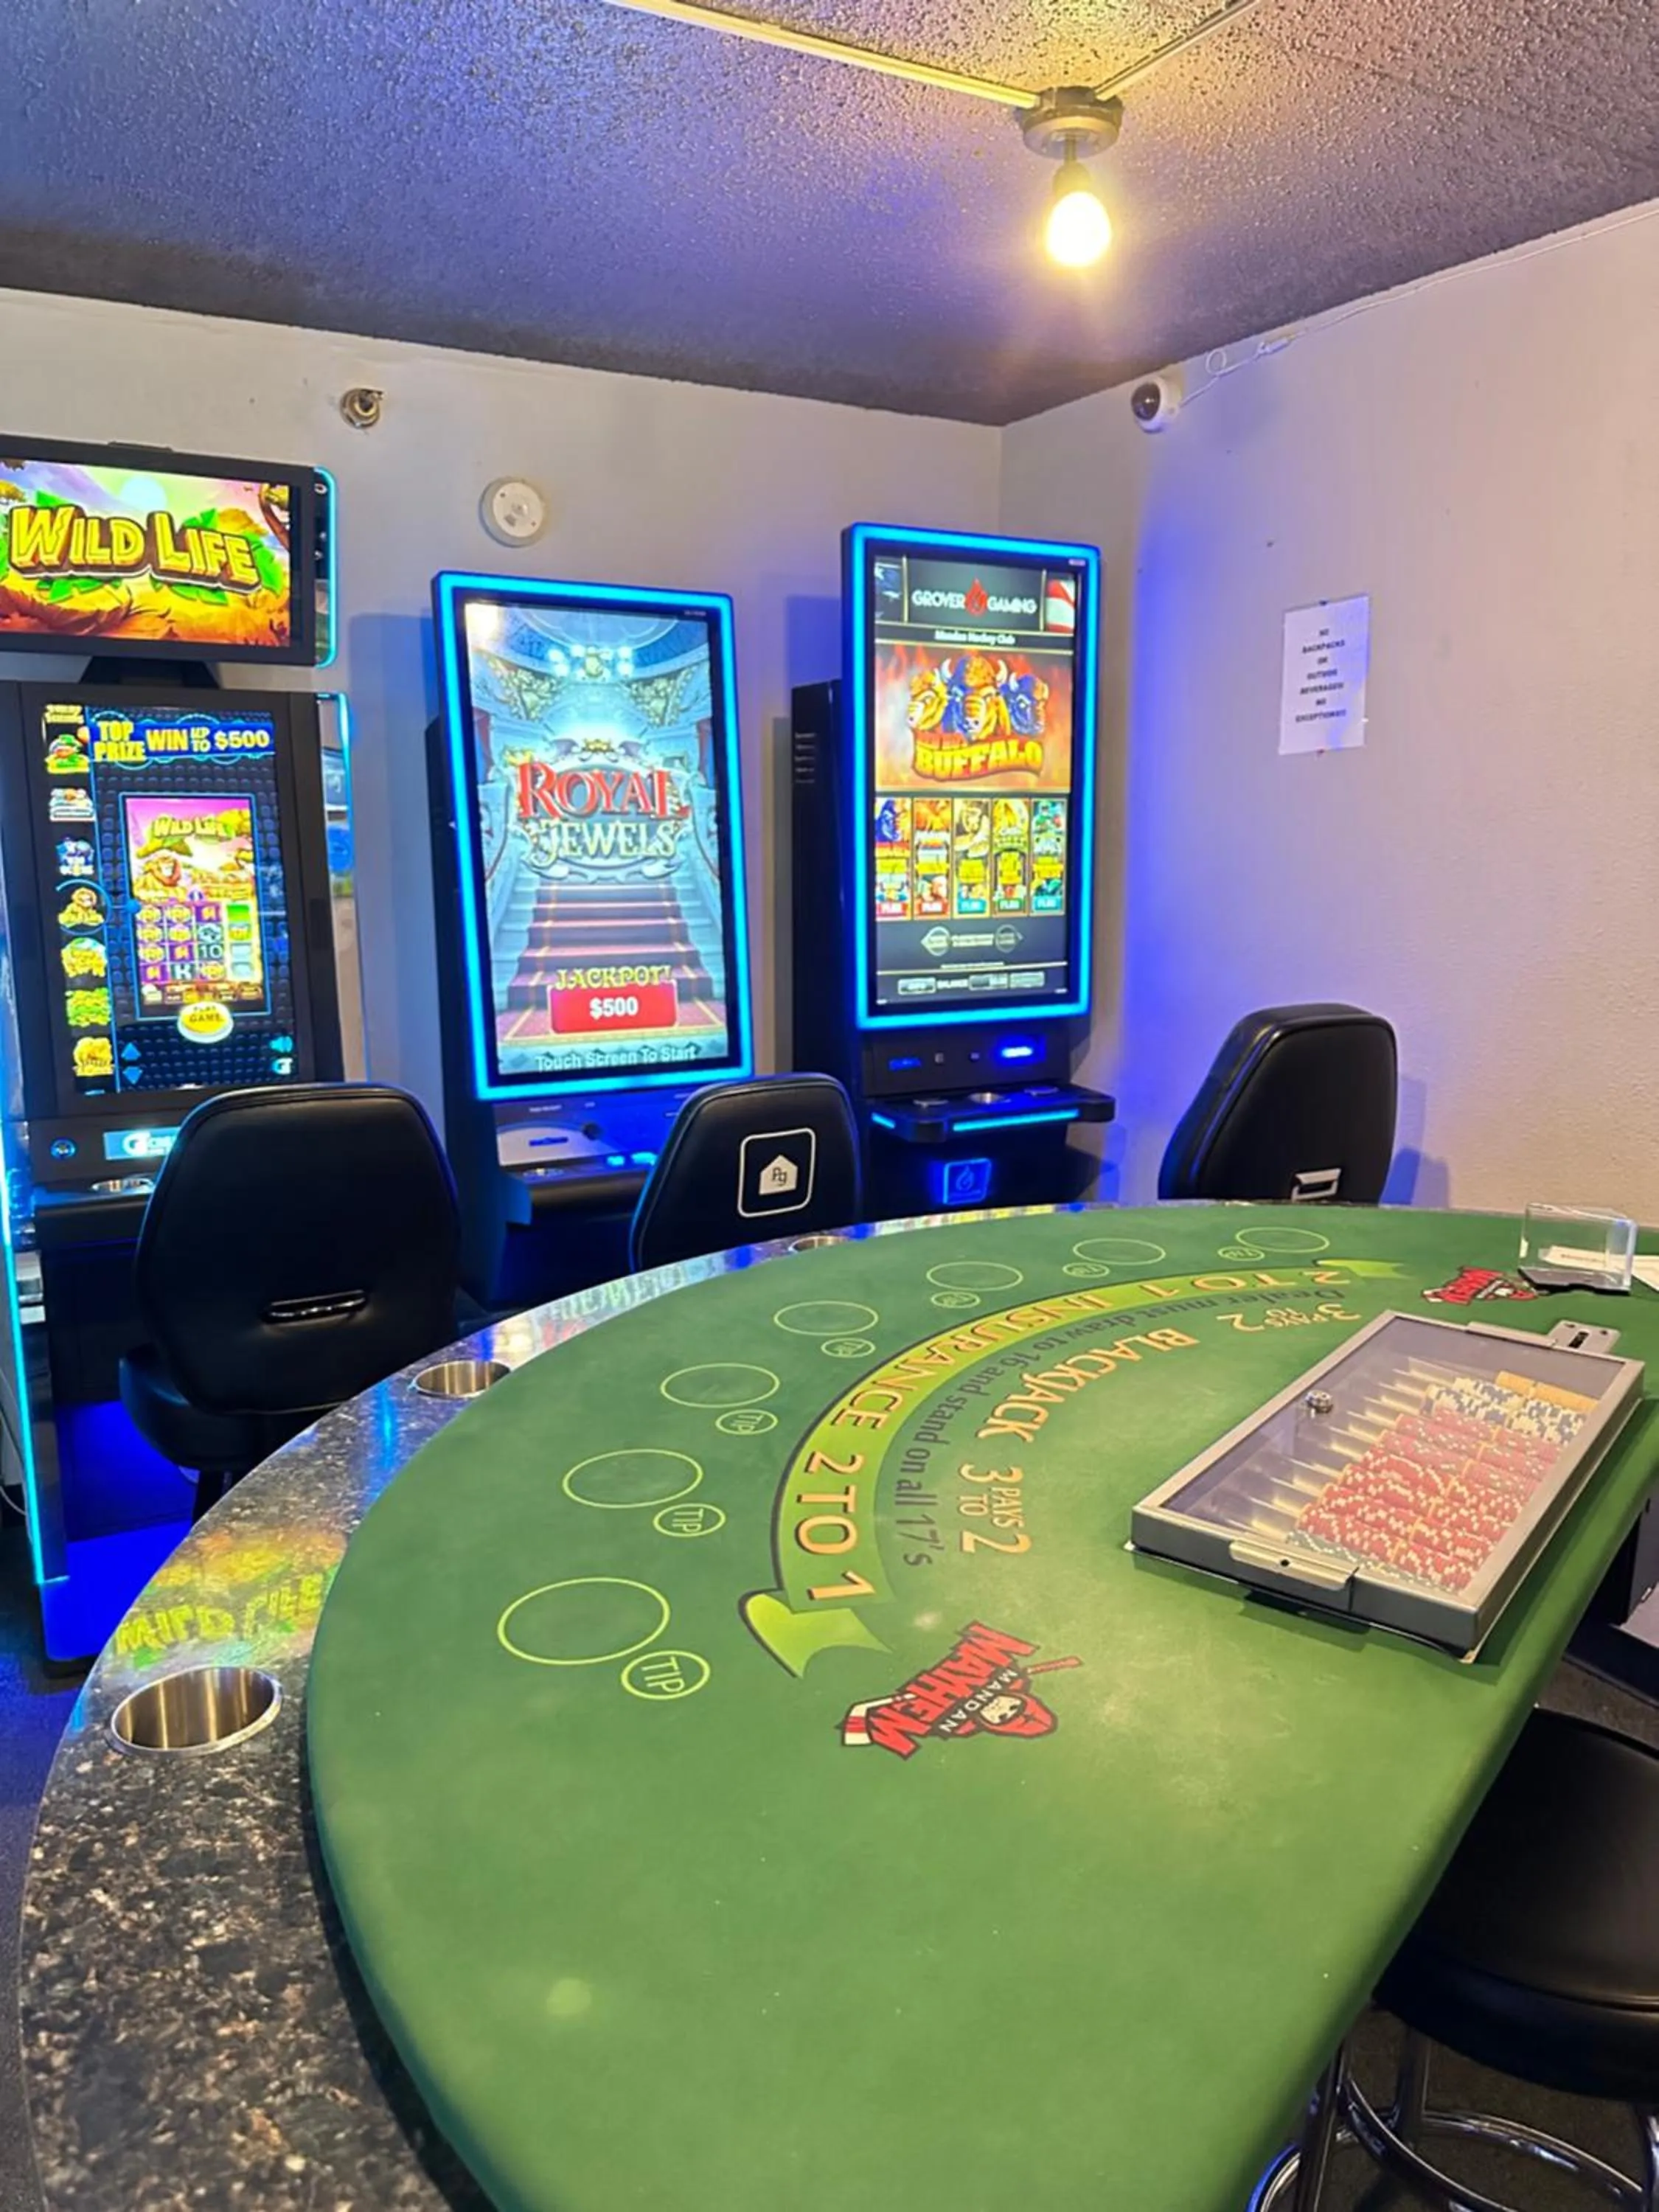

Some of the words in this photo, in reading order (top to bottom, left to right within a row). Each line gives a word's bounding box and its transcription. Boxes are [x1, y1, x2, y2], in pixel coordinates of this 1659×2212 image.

[10, 504, 146, 572] WILD
[149, 512, 261, 592] LIFE
[911, 590, 965, 610] GROVER
[987, 596, 1038, 615] GAMING
[1302, 639, 1345, 654] BACKPACKS
[1307, 669, 1338, 680] OUTSIDE
[97, 721, 133, 741] TOP
[146, 729, 188, 751] WIN
[191, 727, 210, 739] UP
[215, 730, 270, 751] $500
[94, 741, 147, 762] PRIZE
[192, 740, 211, 752] TO
[915, 740, 1044, 779] BUFFALO
[515, 761, 691, 820] ROYAL
[529, 820, 676, 869] JEWELS
[555, 965, 672, 990] JACKPOT!
[590, 997, 640, 1020] $500
[535, 1051, 581, 1073] Touch
[585, 1050, 638, 1068] Screen
[641, 1048, 657, 1062] To
[660, 1045, 698, 1060] Start
[1138, 1284, 1180, 1298] 1
[1192, 1273, 1298, 1292] TO
[1065, 1315, 1136, 1340] draw
[1217, 1313, 1265, 1331] 2
[1033, 1335, 1069, 1352] to
[830, 1294, 1113, 1430] INSURANCE
[1000, 1351, 1041, 1369] 16
[957, 1366, 1005, 1396] and
[976, 1328, 1200, 1442] BLACKJACK
[731, 1413, 765, 1432] TIP
[913, 1394, 968, 1445] stand
[804, 1451, 865, 1475] 2
[900, 1447, 931, 1474] on
[959, 1464, 1023, 1484] 3
[894, 1478, 938, 1506] all
[960, 1494, 989, 1517] TO
[992, 1487, 1024, 1528] PAYS
[671, 1508, 704, 1534] TIP
[794, 1485, 859, 1556] TO
[895, 1514, 945, 1567] 17's
[961, 1530, 1032, 1554] 2
[807, 1571, 876, 1601] 1
[641, 1656, 686, 1693] TIP
[870, 1620, 1039, 1759] MAYHEM
[939, 1669, 1018, 1733] MANDAN
